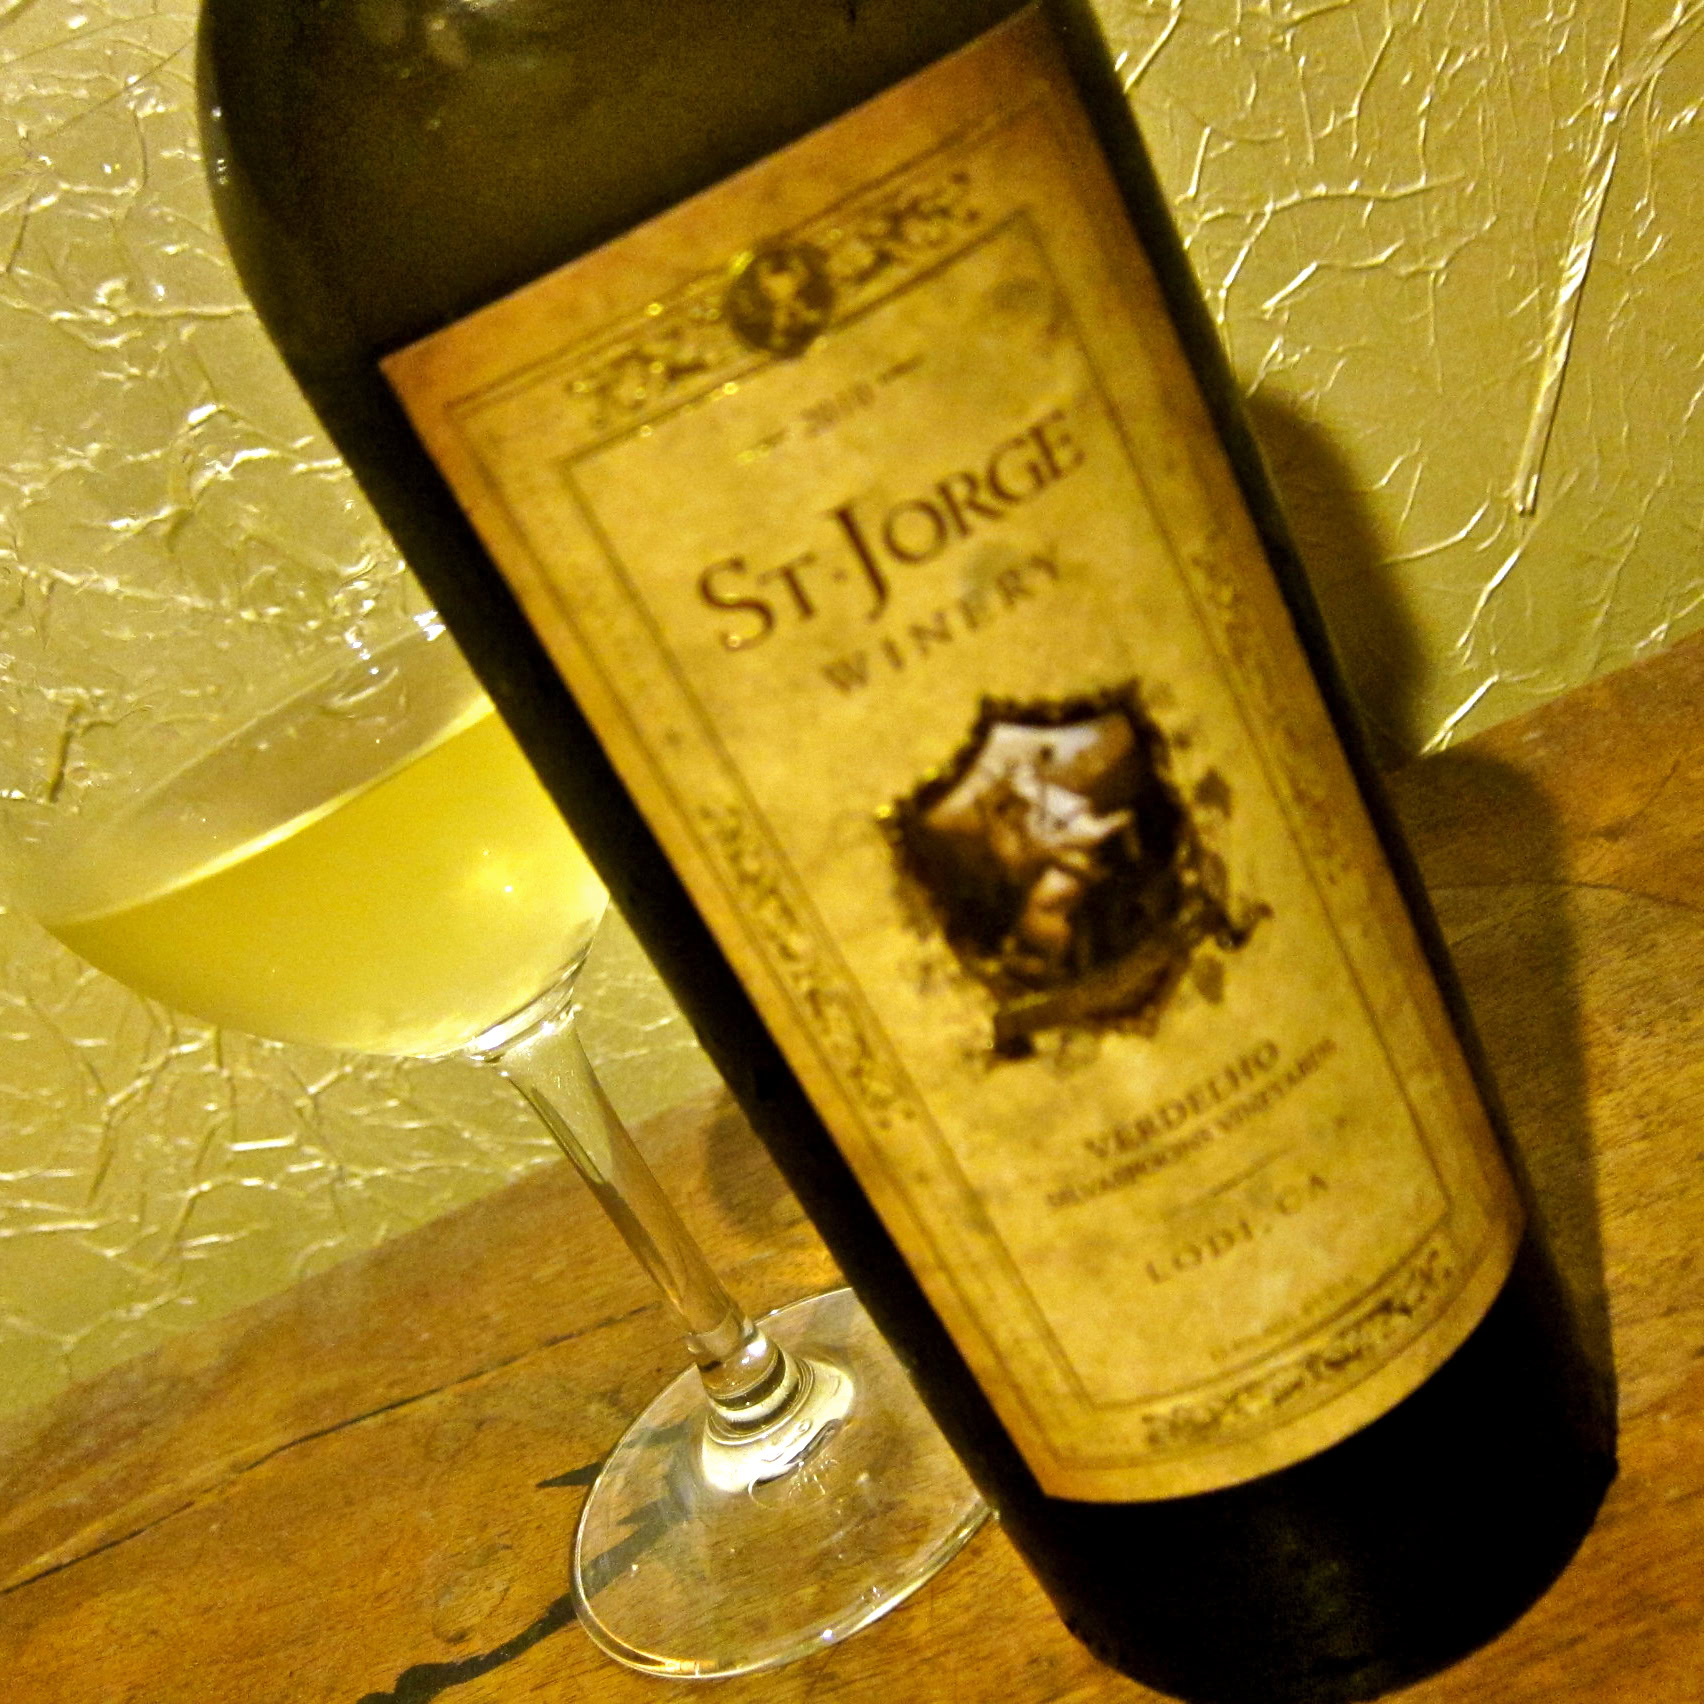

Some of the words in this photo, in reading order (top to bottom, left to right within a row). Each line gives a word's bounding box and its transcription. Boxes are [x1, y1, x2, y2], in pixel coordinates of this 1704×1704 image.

[828, 408, 1088, 623] JORGE
[821, 543, 1060, 696] WINERY
[1083, 1038, 1280, 1159] VERDELHO
[1274, 1173, 1330, 1217] CA
